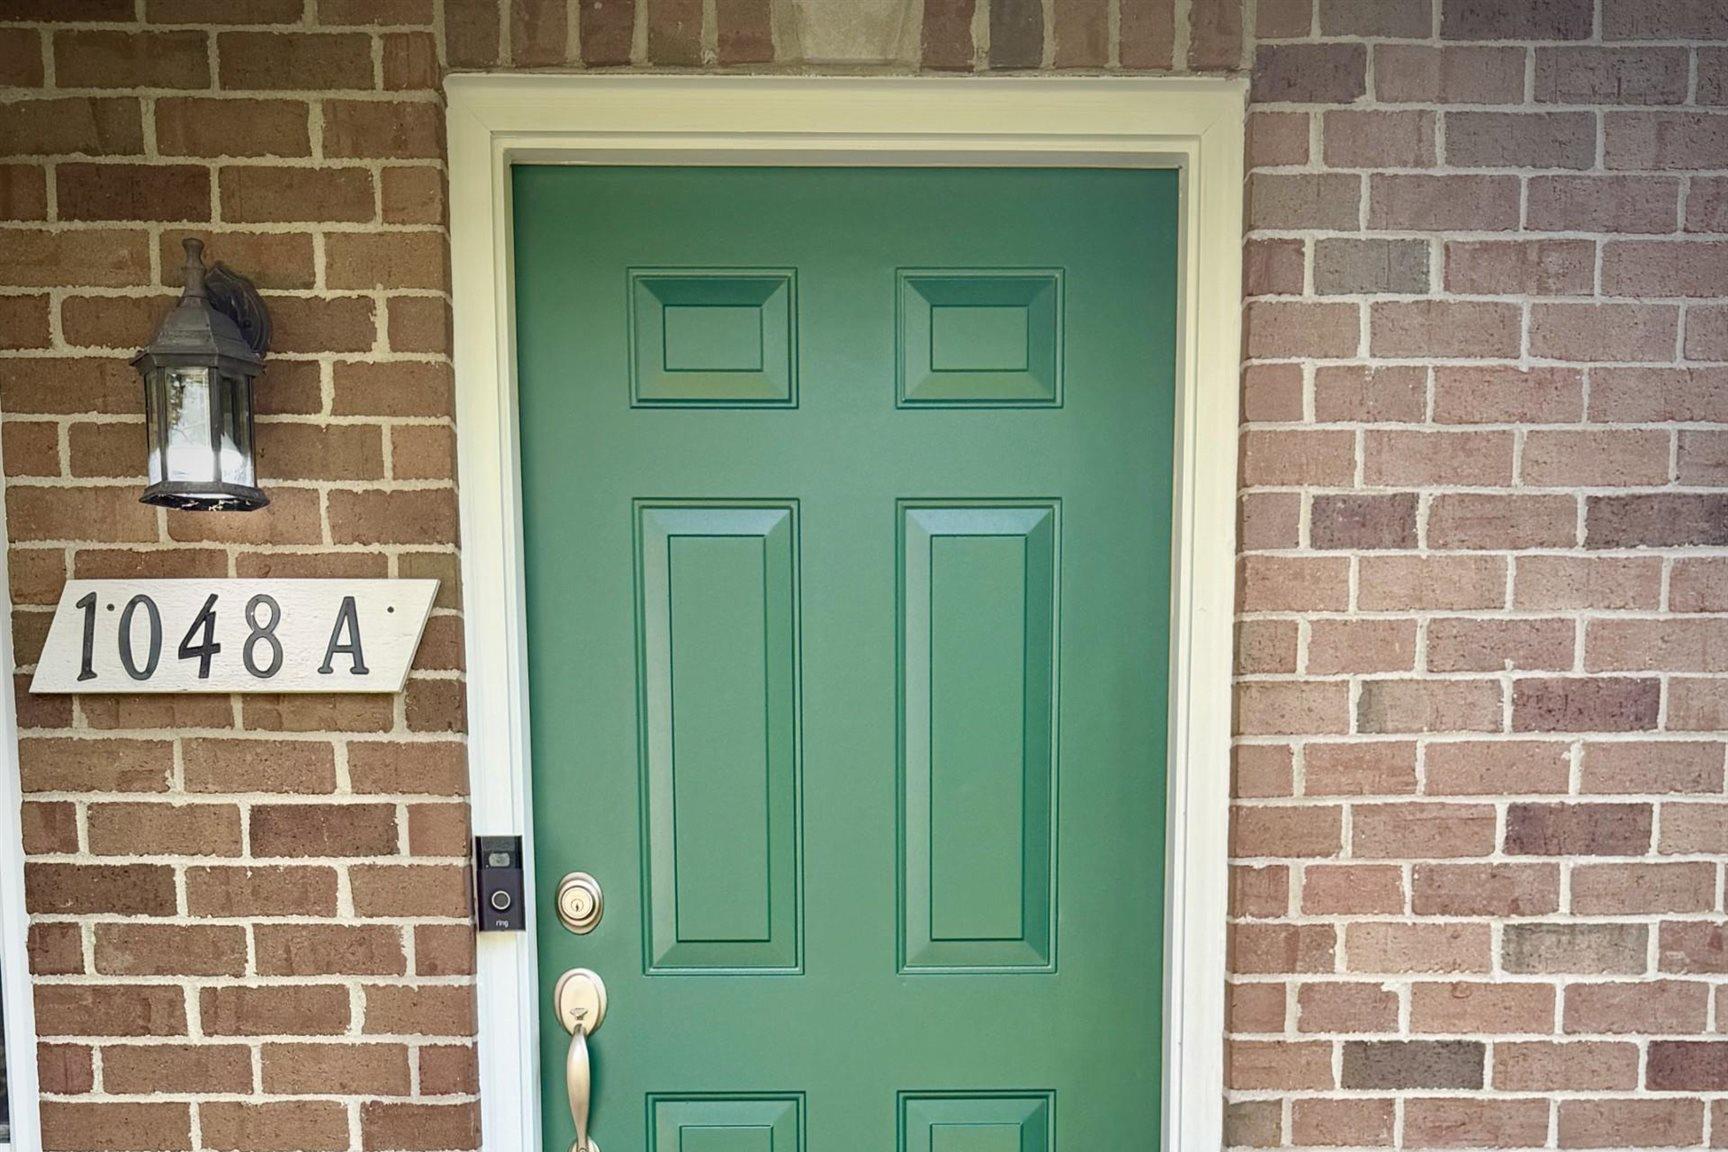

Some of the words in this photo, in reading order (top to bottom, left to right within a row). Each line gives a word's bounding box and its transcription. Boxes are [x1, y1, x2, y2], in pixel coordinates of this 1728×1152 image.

[76, 591, 283, 681] 1048
[317, 596, 370, 675] A
[495, 919, 509, 928] ring
